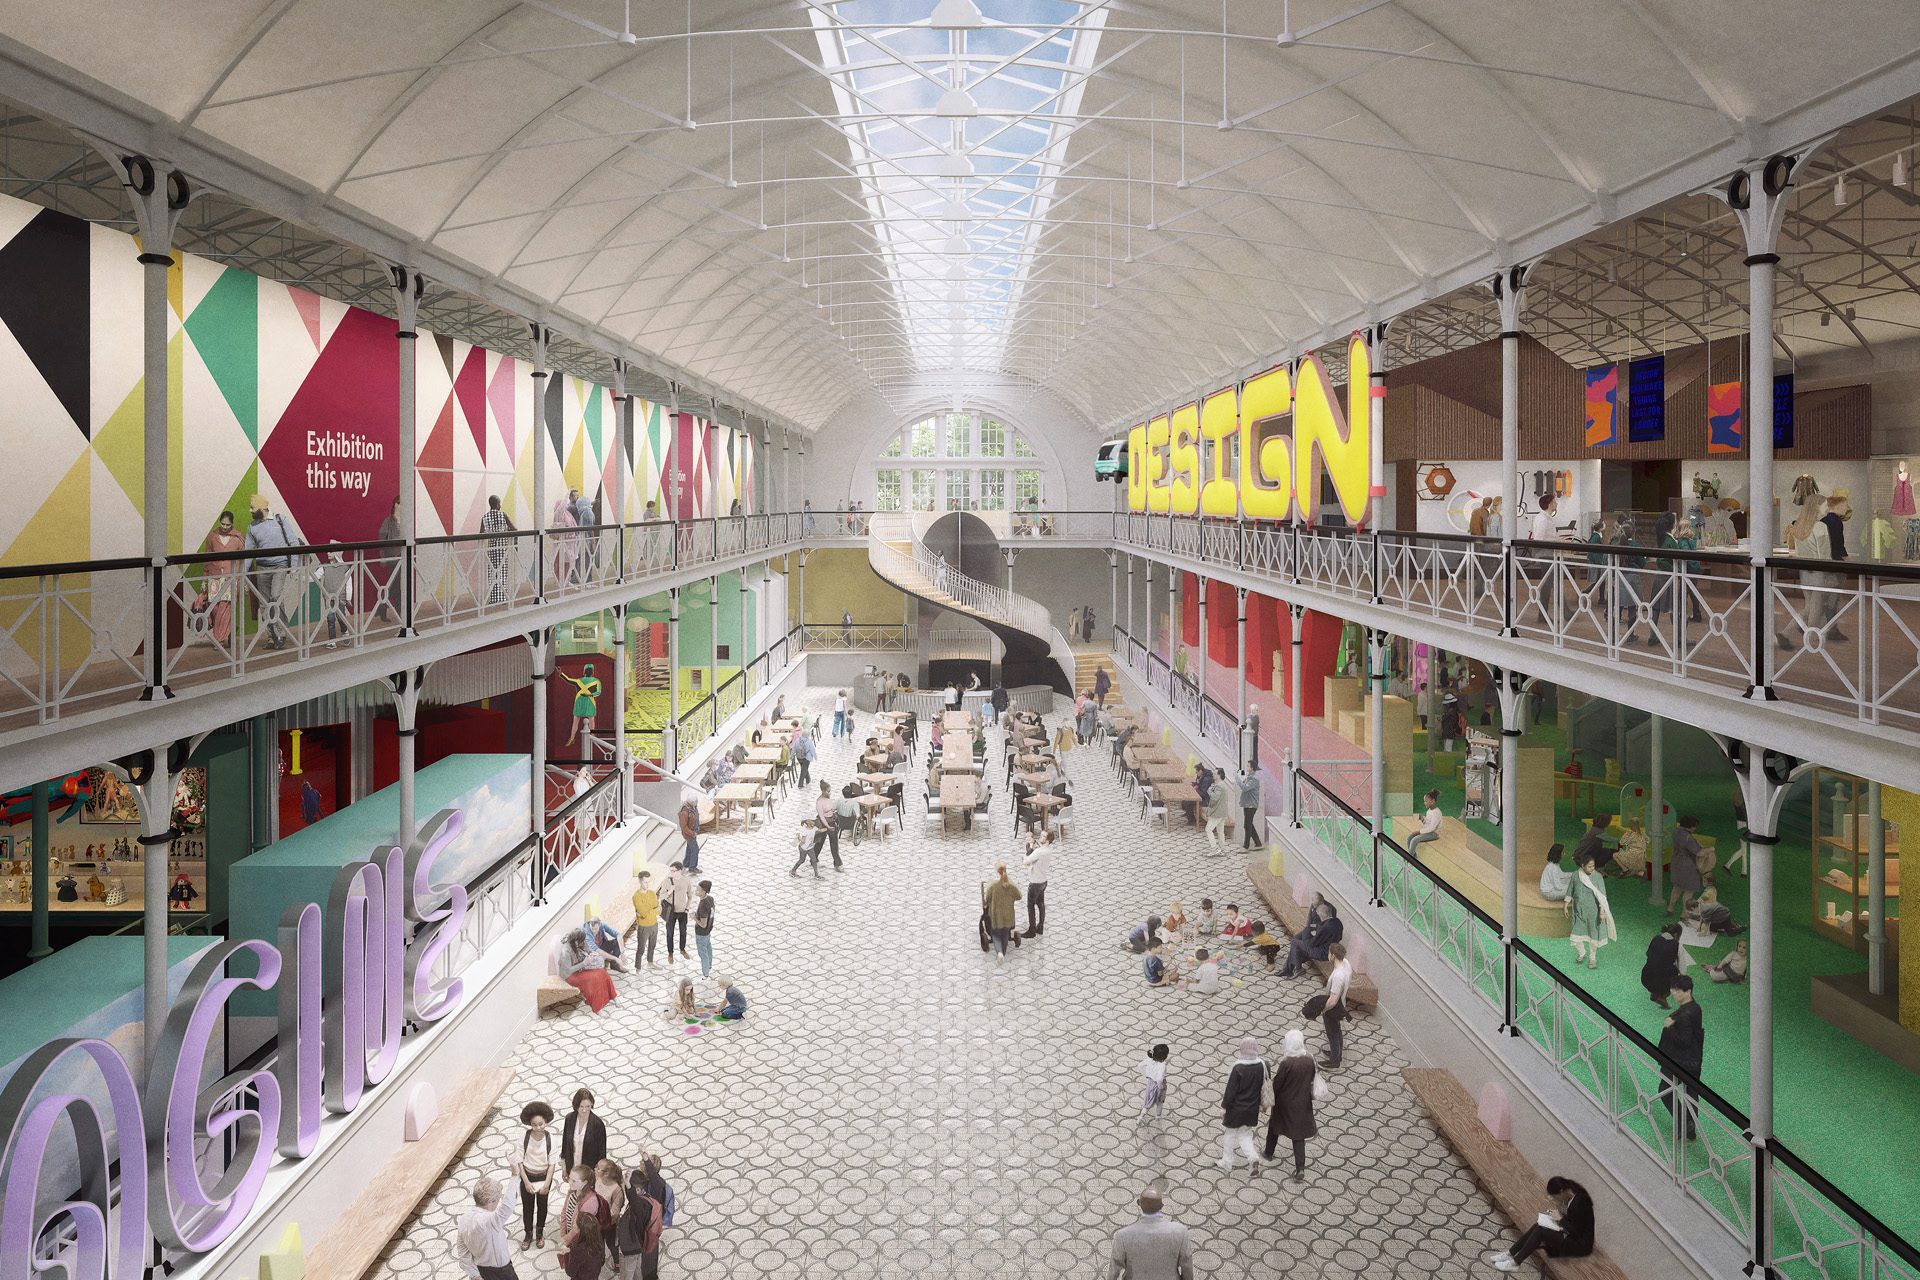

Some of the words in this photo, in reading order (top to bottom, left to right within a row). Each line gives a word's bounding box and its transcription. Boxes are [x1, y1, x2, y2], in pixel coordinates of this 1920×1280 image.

[1634, 368, 1659, 381] DESIGN
[1630, 384, 1643, 394] CAN
[1644, 380, 1662, 392] MAKE
[1633, 394, 1657, 405] THINGS
[1631, 407, 1646, 418] LAST
[1648, 405, 1660, 416] FOR
[1128, 335, 1372, 525] DESIGN
[1634, 418, 1659, 430] LONGER
[307, 430, 383, 460] Exhibition
[306, 462, 337, 489] this
[341, 471, 371, 498] way
